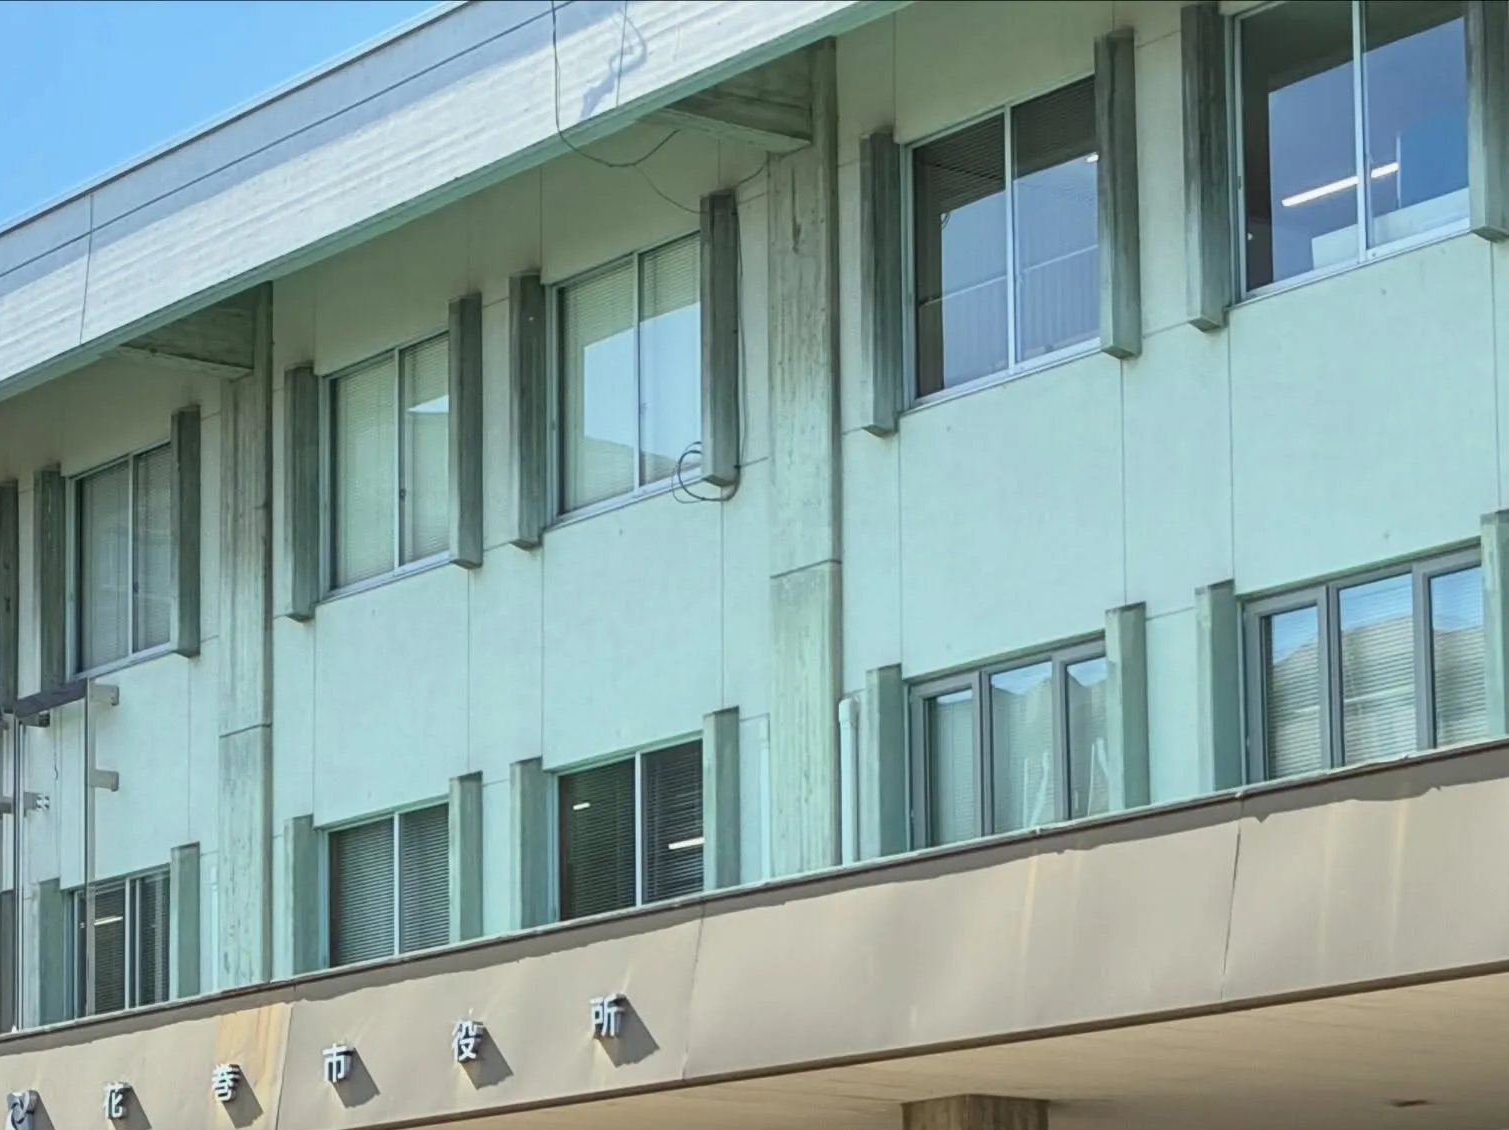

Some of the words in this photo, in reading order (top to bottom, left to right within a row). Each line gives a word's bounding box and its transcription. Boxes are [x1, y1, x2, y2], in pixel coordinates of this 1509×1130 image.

[101, 993, 627, 1121] 花巻市役所
